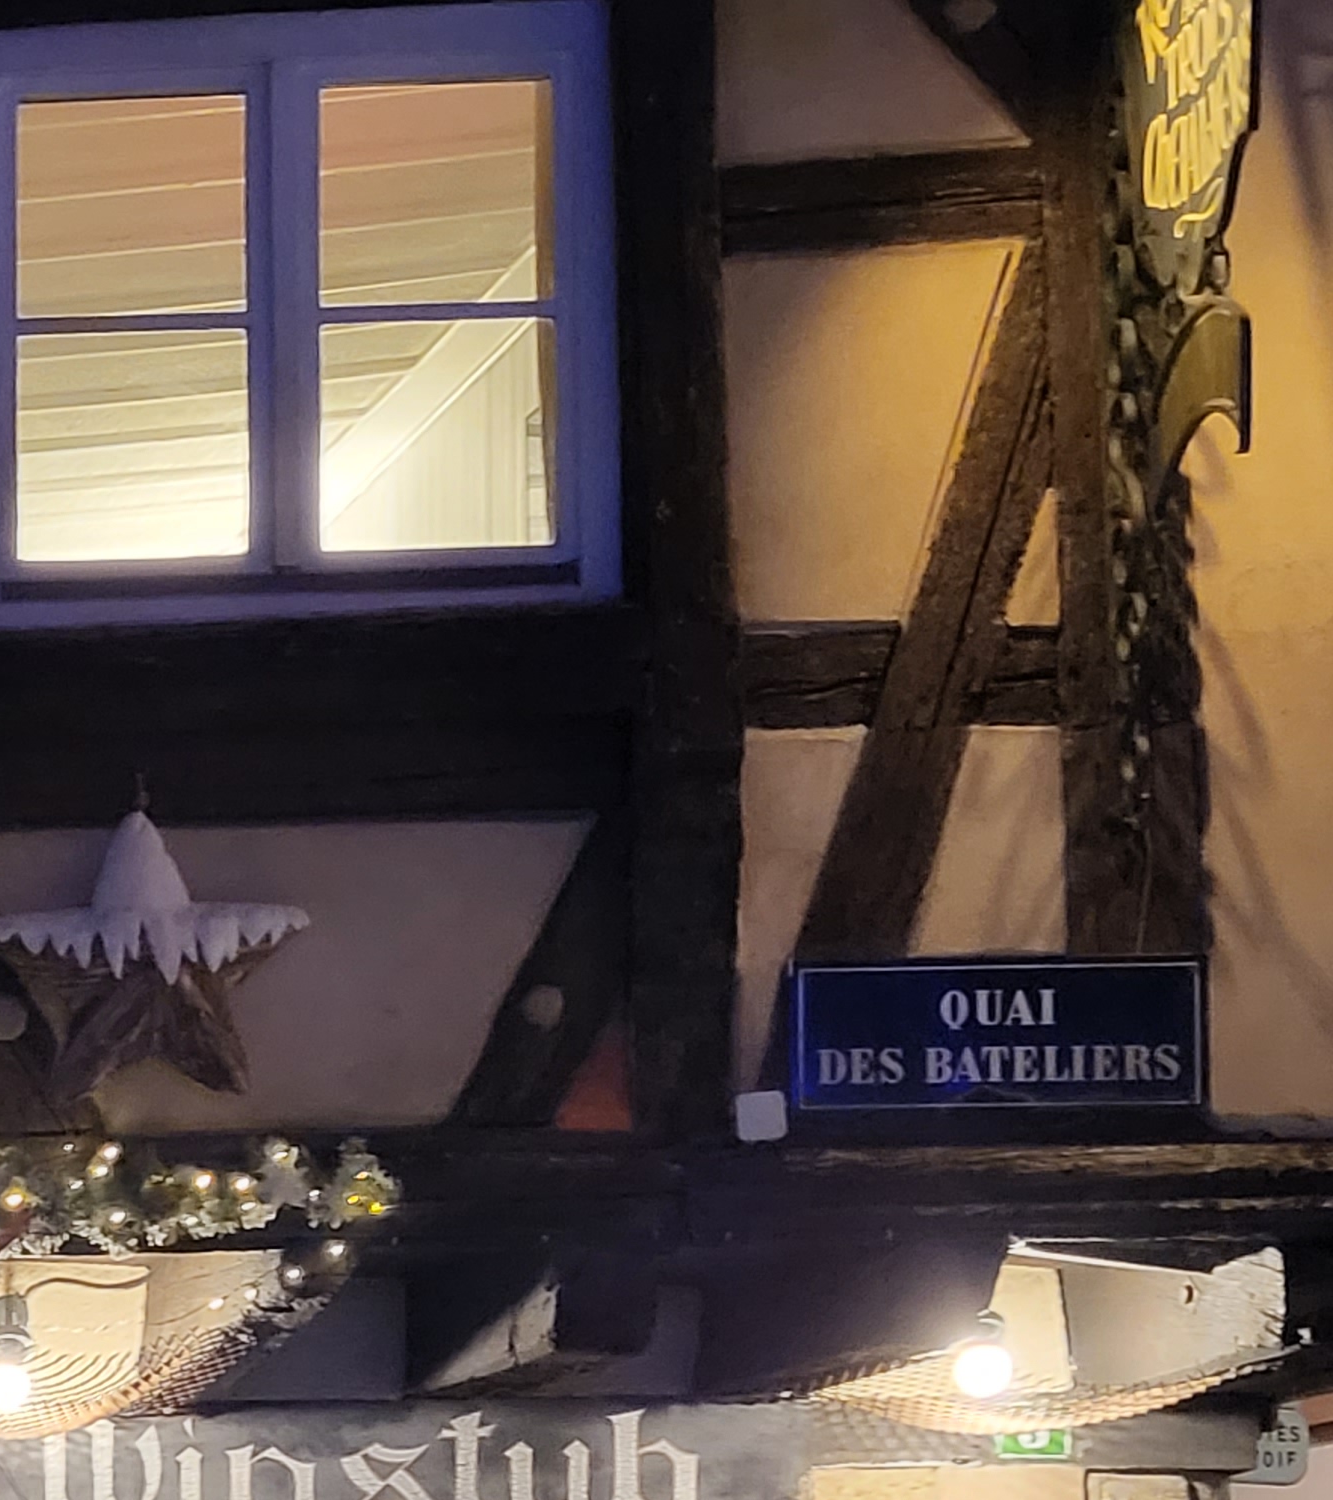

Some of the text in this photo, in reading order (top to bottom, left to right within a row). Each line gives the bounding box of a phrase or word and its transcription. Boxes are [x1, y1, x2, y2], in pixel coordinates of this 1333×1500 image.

[939, 988, 1056, 1031] QUAI
[817, 1043, 1182, 1086] DES BATELIERS
